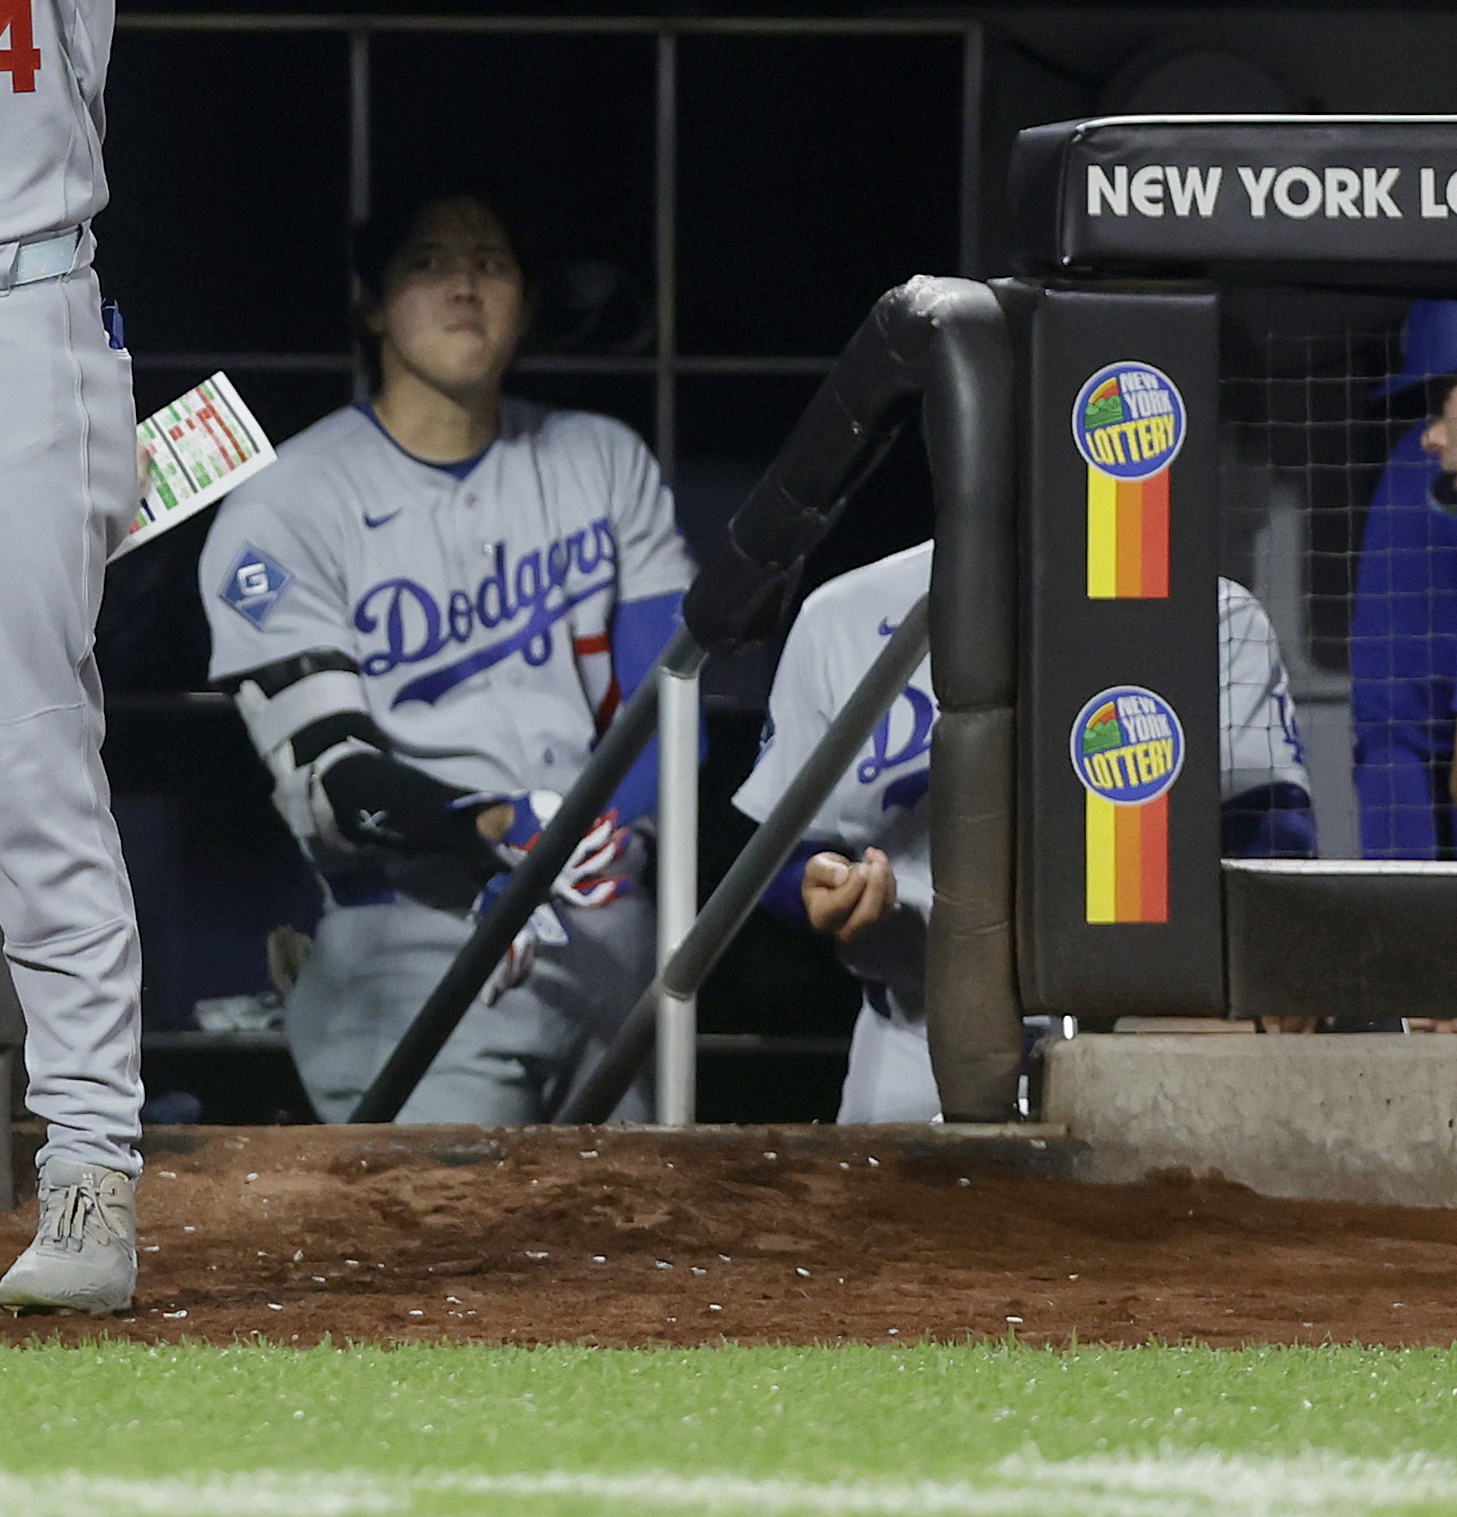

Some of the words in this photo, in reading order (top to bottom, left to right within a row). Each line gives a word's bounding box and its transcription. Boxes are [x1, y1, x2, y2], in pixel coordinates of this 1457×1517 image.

[1087, 165, 1223, 218] NEW
[1237, 166, 1403, 219] YORK
[1420, 167, 1457, 218] L
[1119, 371, 1159, 394] NEW
[1124, 389, 1174, 419] YORK
[1085, 413, 1176, 466] LOTTERY
[355, 518, 615, 683] Dodgers
[1116, 695, 1157, 718] NEW
[1121, 713, 1173, 744] YORK
[1083, 737, 1174, 790] LOTTERY
